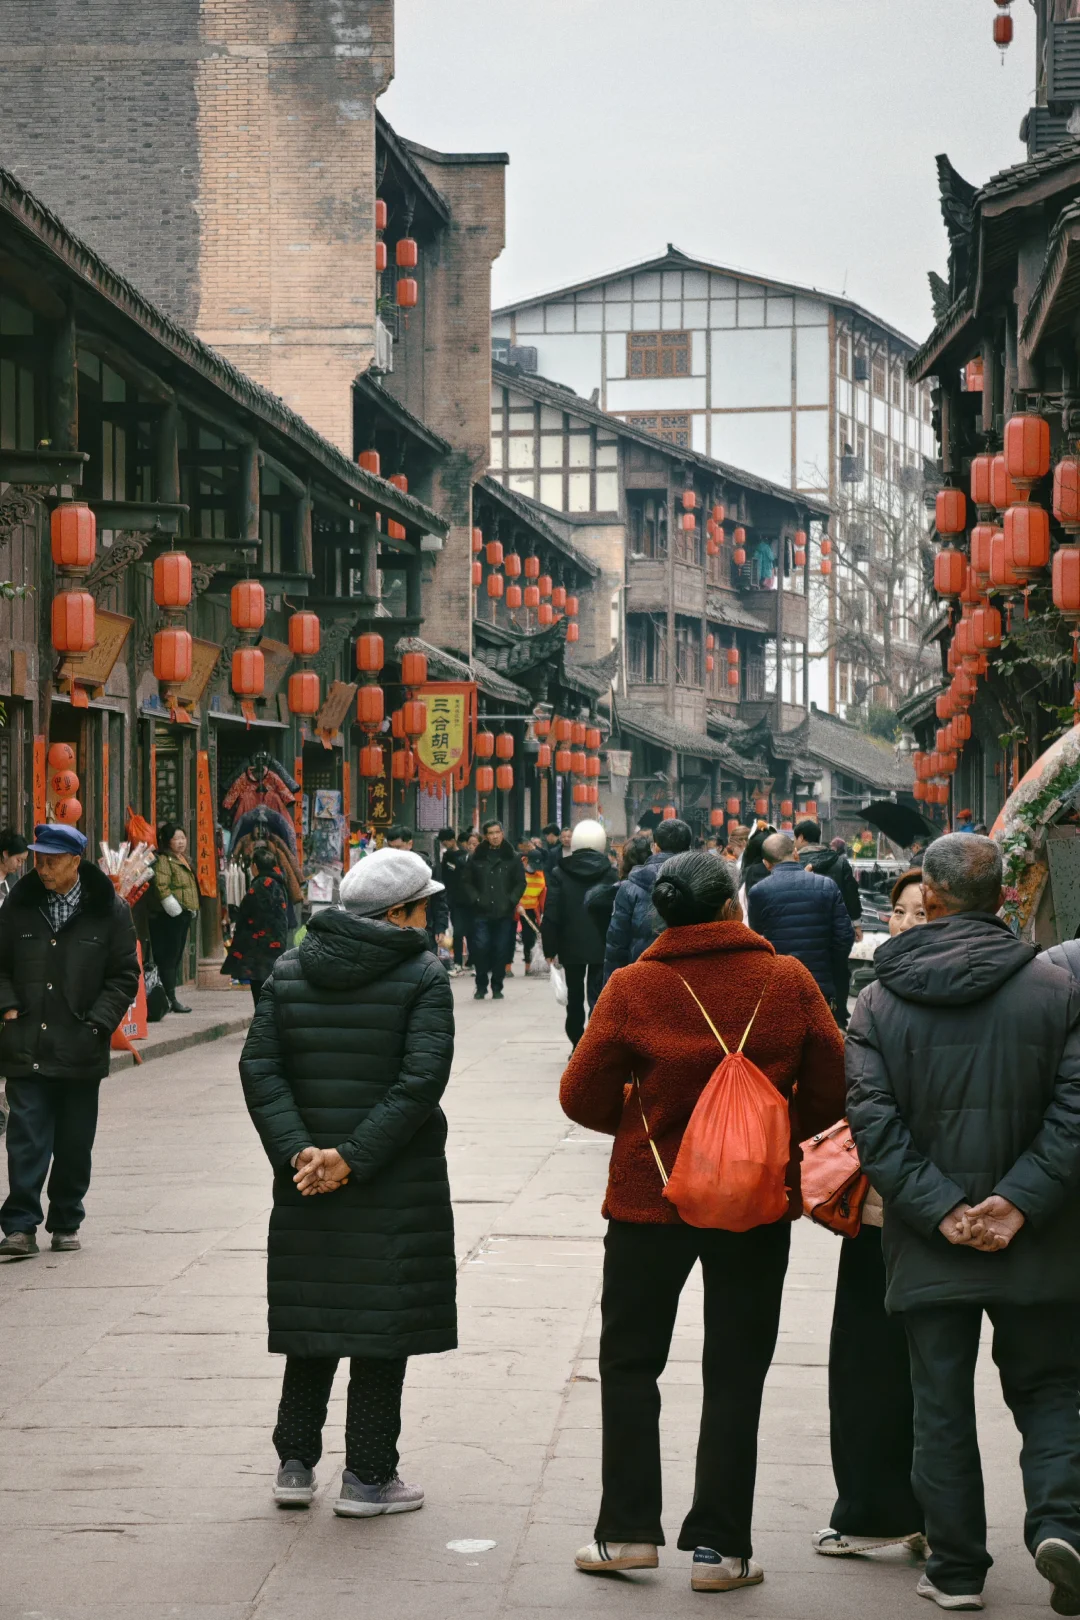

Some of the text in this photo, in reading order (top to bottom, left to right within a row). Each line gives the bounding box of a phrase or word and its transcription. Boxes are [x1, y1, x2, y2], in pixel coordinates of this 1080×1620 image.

[431, 698, 450, 766] 三合胡豆
[372, 743, 387, 817] 麻花
